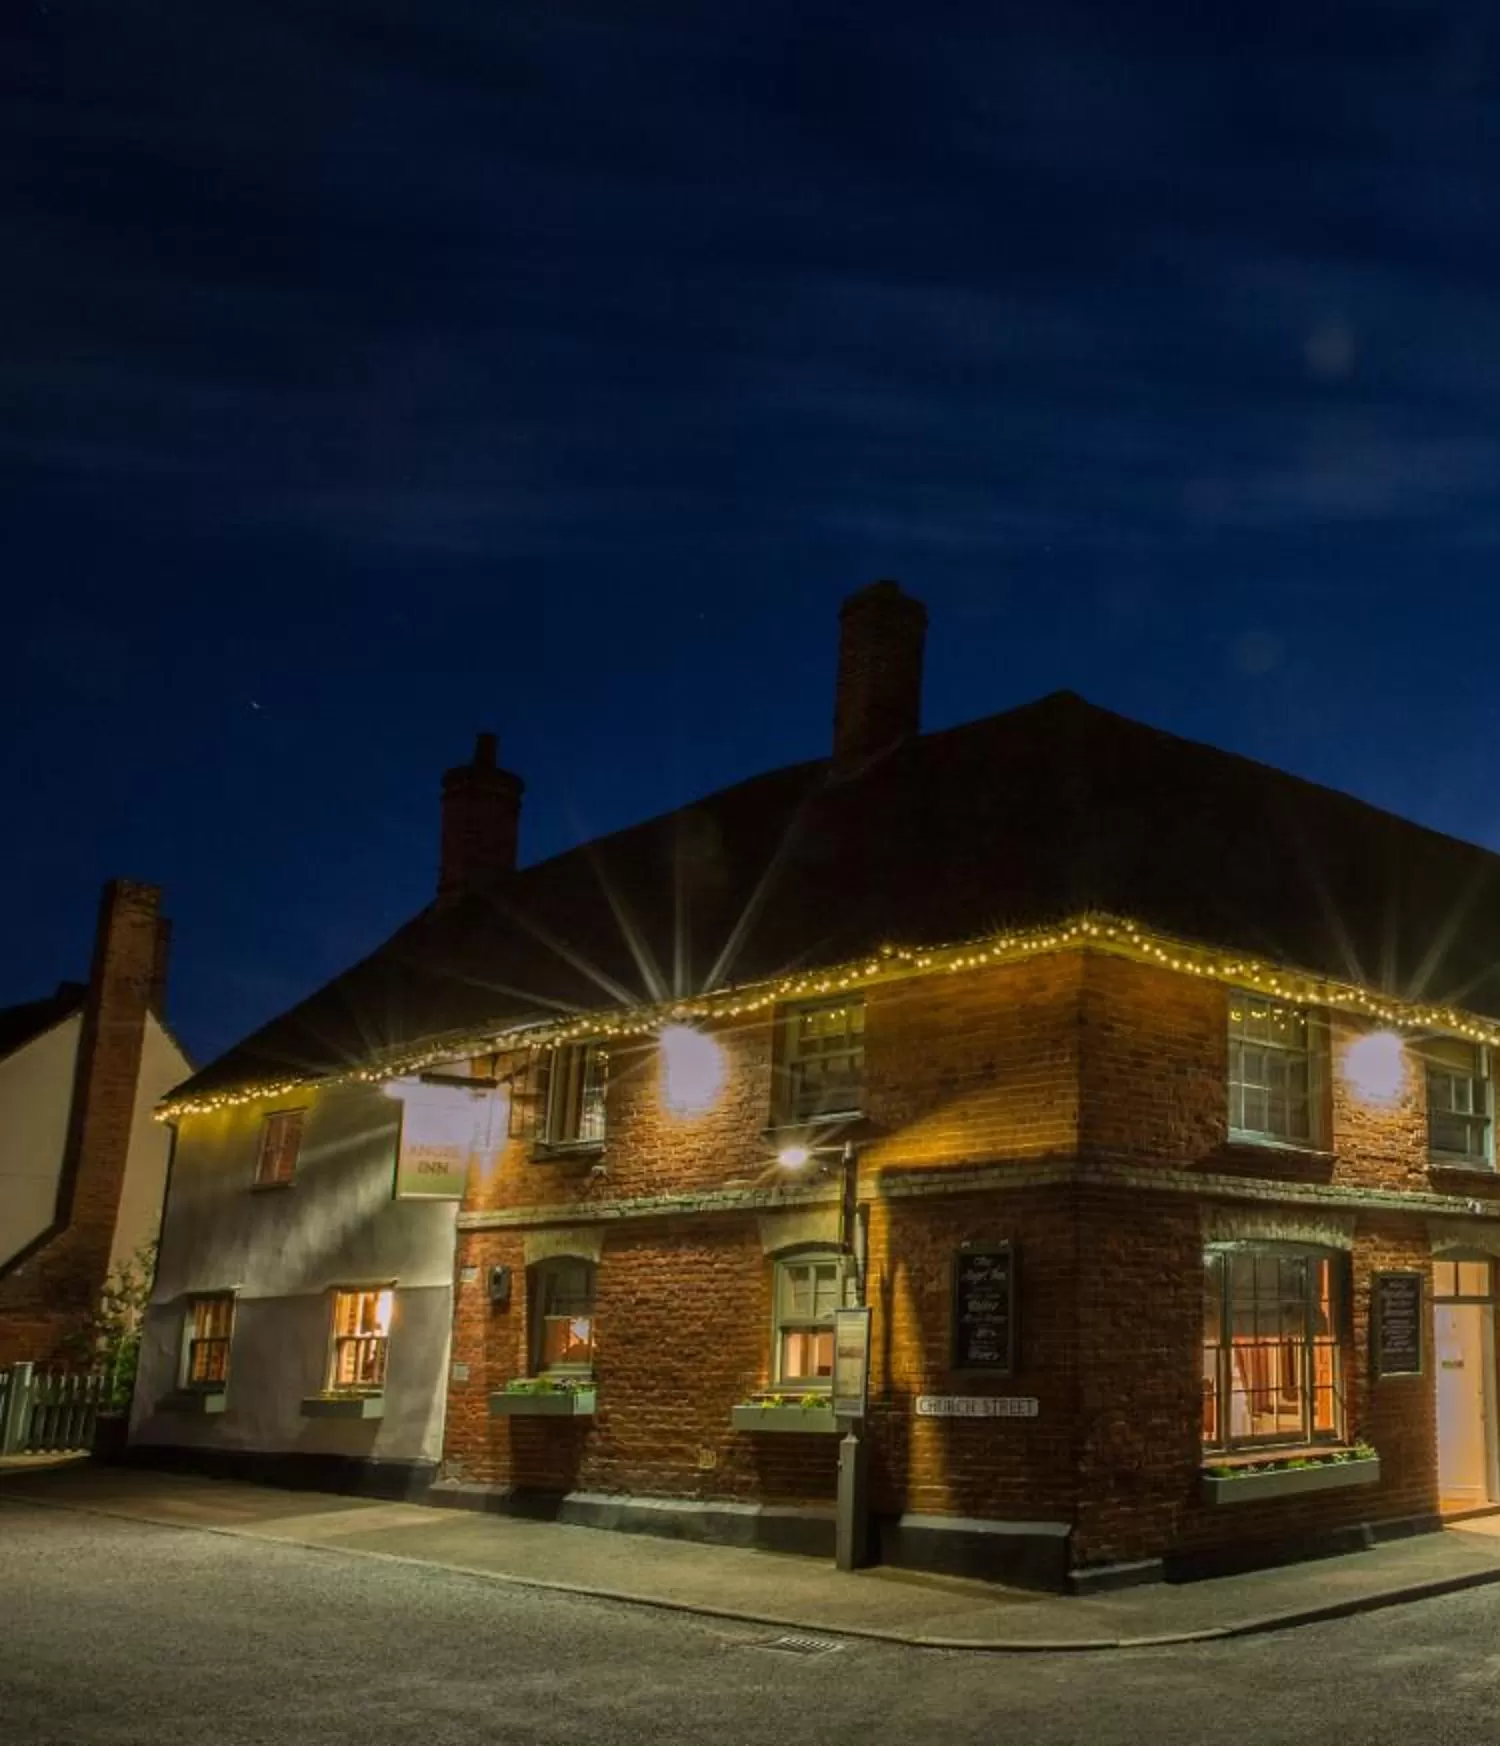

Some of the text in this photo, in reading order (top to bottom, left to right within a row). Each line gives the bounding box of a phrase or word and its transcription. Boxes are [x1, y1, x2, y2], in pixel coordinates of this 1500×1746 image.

[417, 1160, 449, 1174] INN
[920, 1400, 1033, 1414] CHURCH STREET
